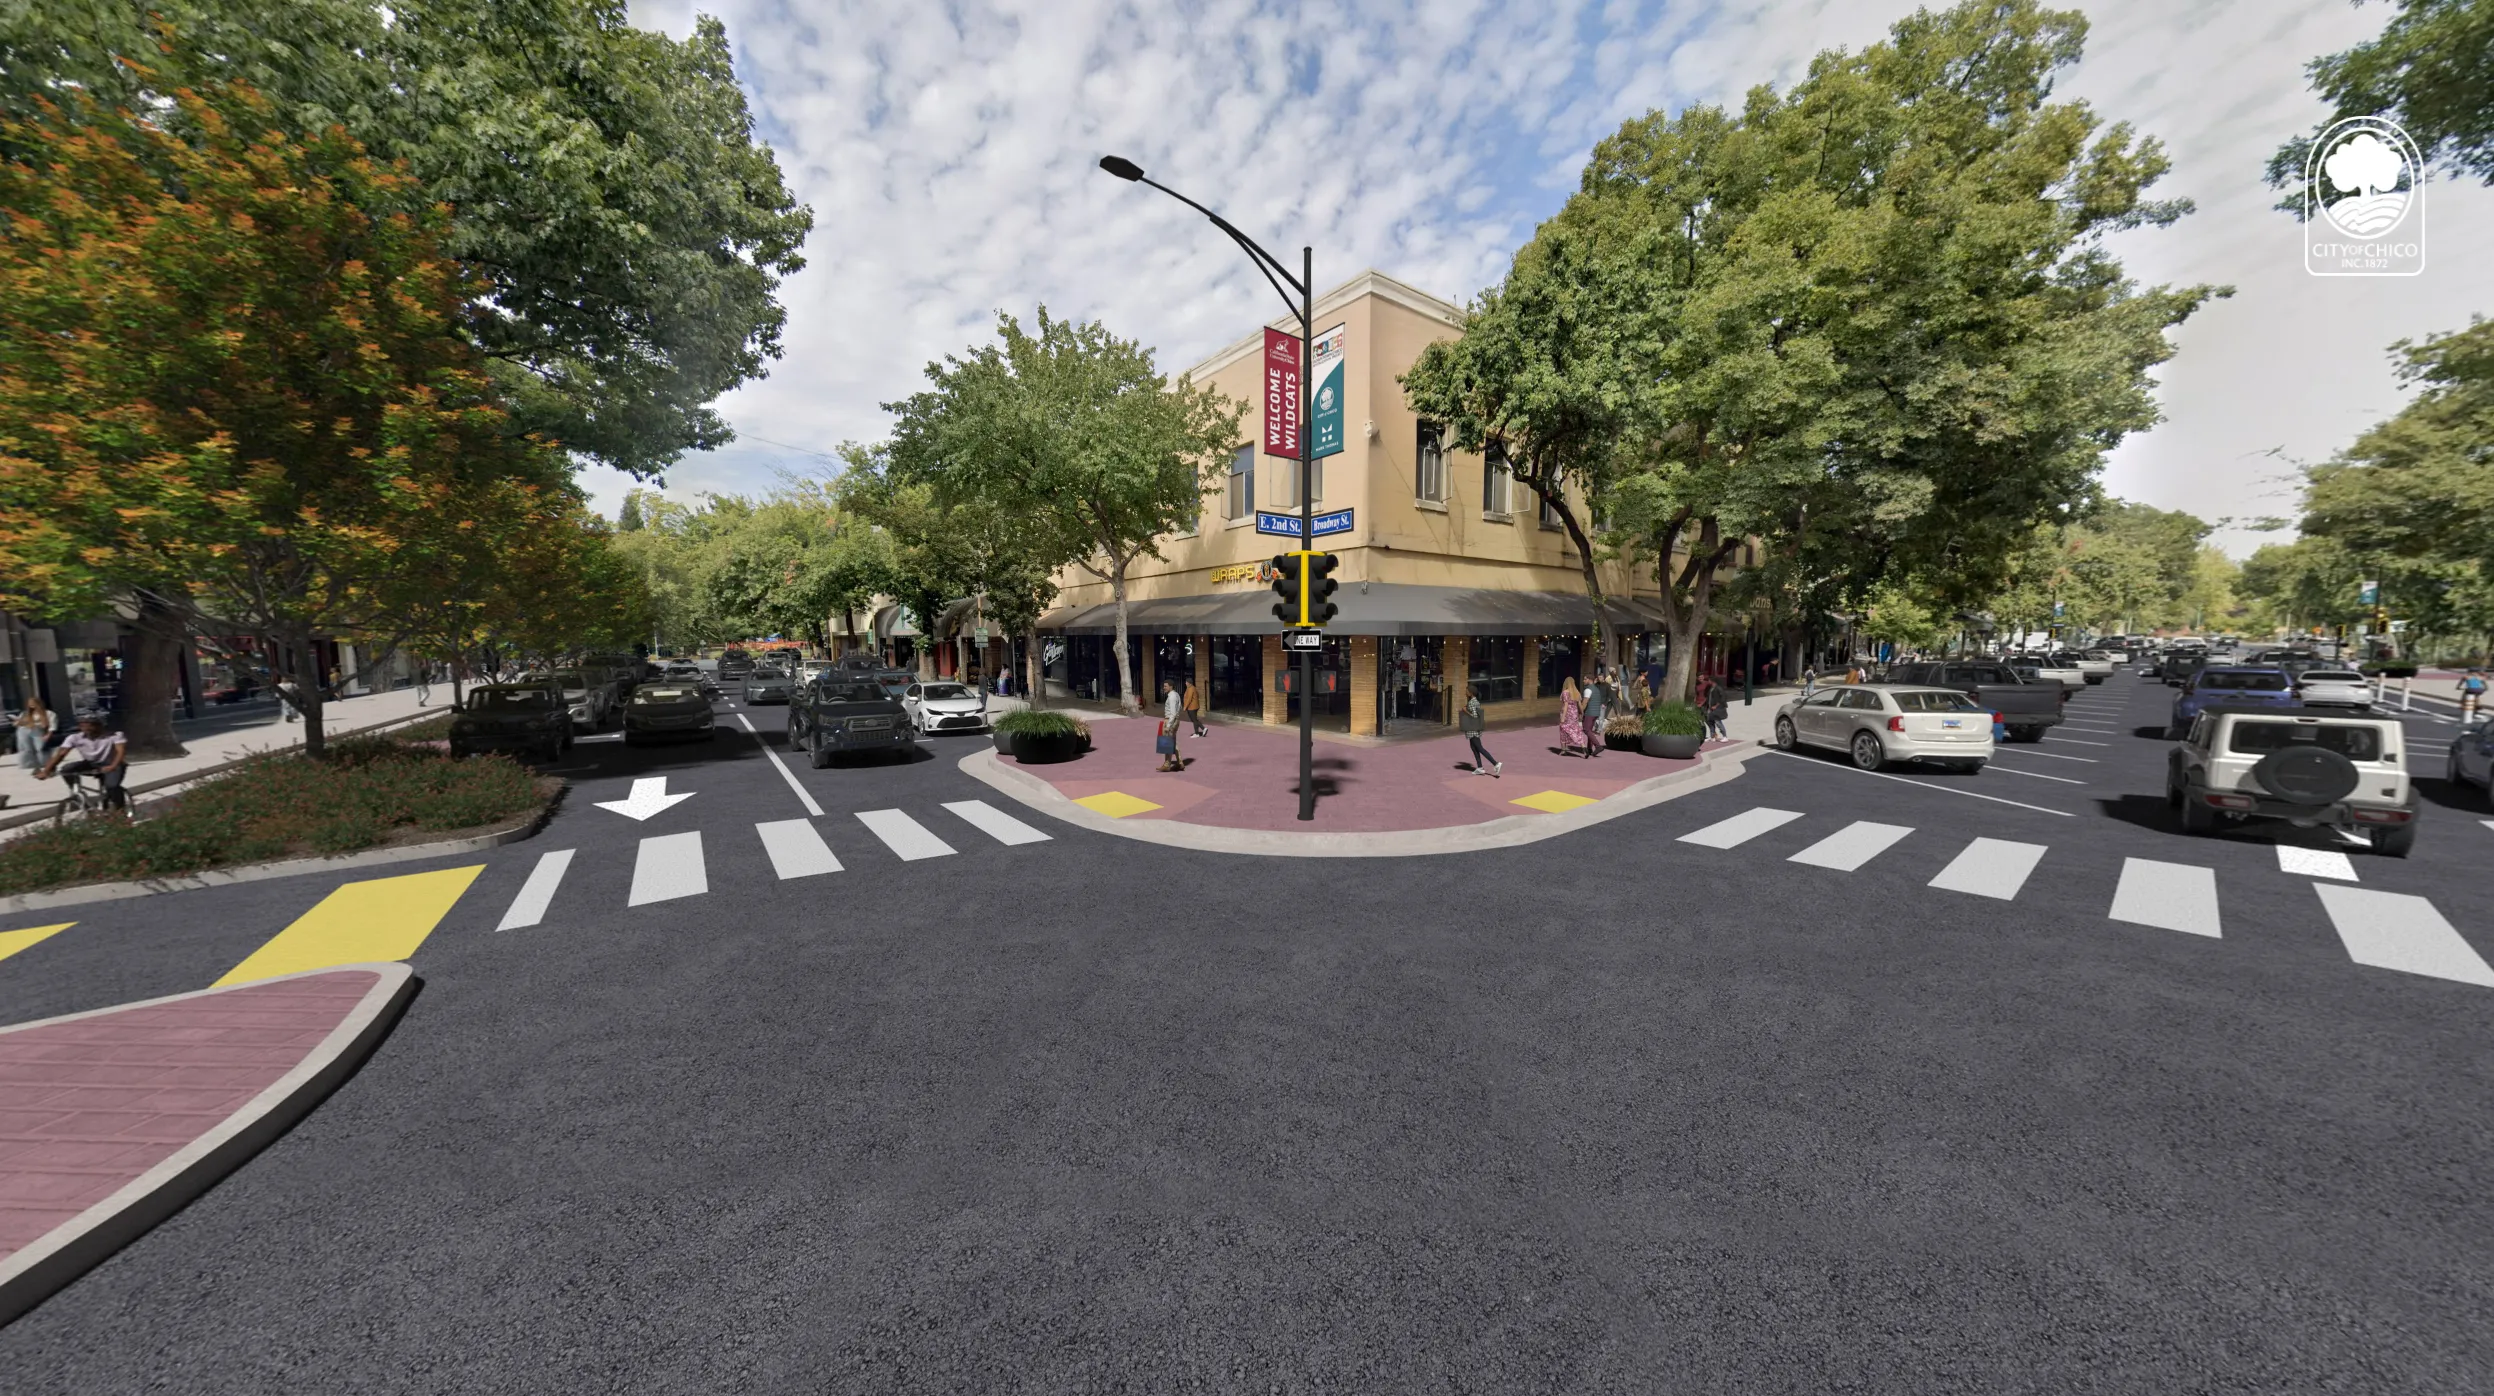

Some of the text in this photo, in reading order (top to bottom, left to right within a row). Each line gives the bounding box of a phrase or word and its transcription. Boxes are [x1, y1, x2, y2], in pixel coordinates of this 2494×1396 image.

[1270, 368, 1281, 446] WELCOME
[1286, 372, 1296, 450] WILDCATS
[1260, 516, 1301, 533] E. 2nd St.
[1313, 514, 1349, 531] Broadway St.
[1305, 636, 1318, 644] WAY
